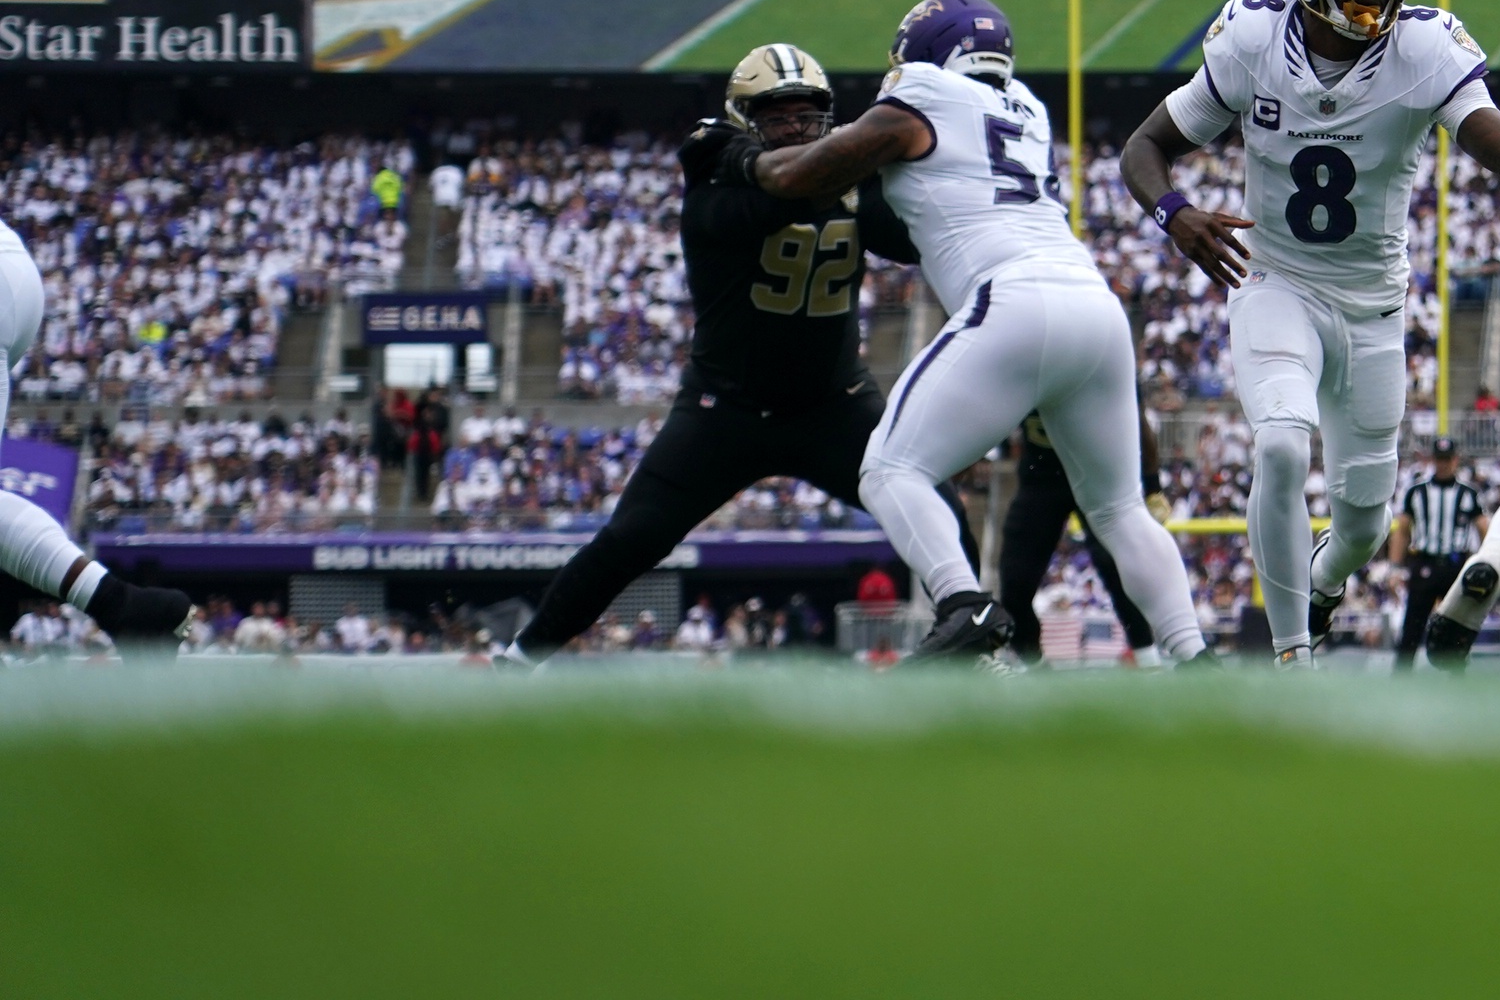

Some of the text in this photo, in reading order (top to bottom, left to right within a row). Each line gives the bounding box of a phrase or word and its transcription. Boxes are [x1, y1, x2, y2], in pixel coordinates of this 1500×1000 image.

[0, 12, 298, 62] Star Health
[1255, 98, 1279, 122] C
[1287, 130, 1364, 142] BALTIMORE
[1285, 145, 1357, 243] 8
[1154, 206, 1167, 225] 8
[751, 218, 860, 317] 92
[313, 546, 369, 568] BUD
[373, 546, 448, 569] LIGHT
